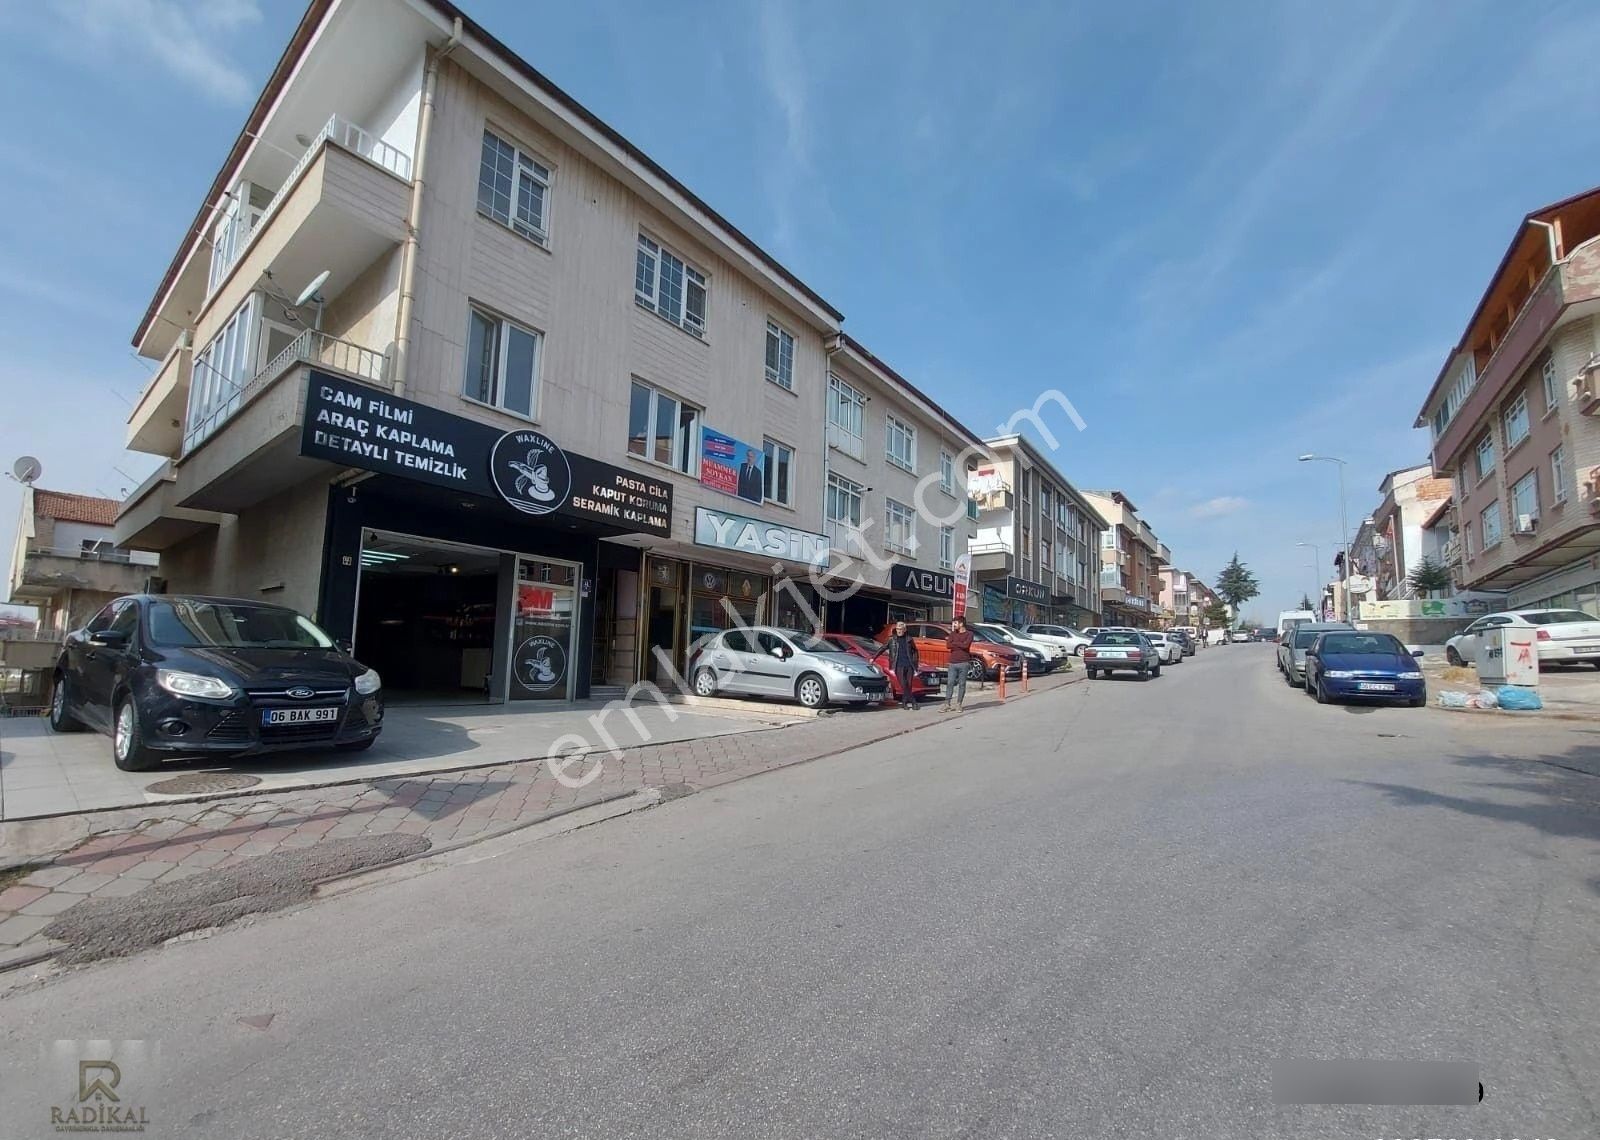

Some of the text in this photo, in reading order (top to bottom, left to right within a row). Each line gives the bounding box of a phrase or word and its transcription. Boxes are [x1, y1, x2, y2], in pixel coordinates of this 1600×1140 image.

[320, 386, 413, 425] CAM FİLMİ
[317, 409, 455, 457] ARAÇ KAPLAMA
[516, 434, 555, 454] WAXLINE
[314, 430, 467, 480] DETAYLI TEMİZLİK
[592, 485, 668, 513] KAPUT KORUMA
[616, 475, 668, 499] PASTA CİLA
[572, 496, 667, 528] SERAMİK KAPLAMA
[271, 709, 335, 722] 06 BAK 991
